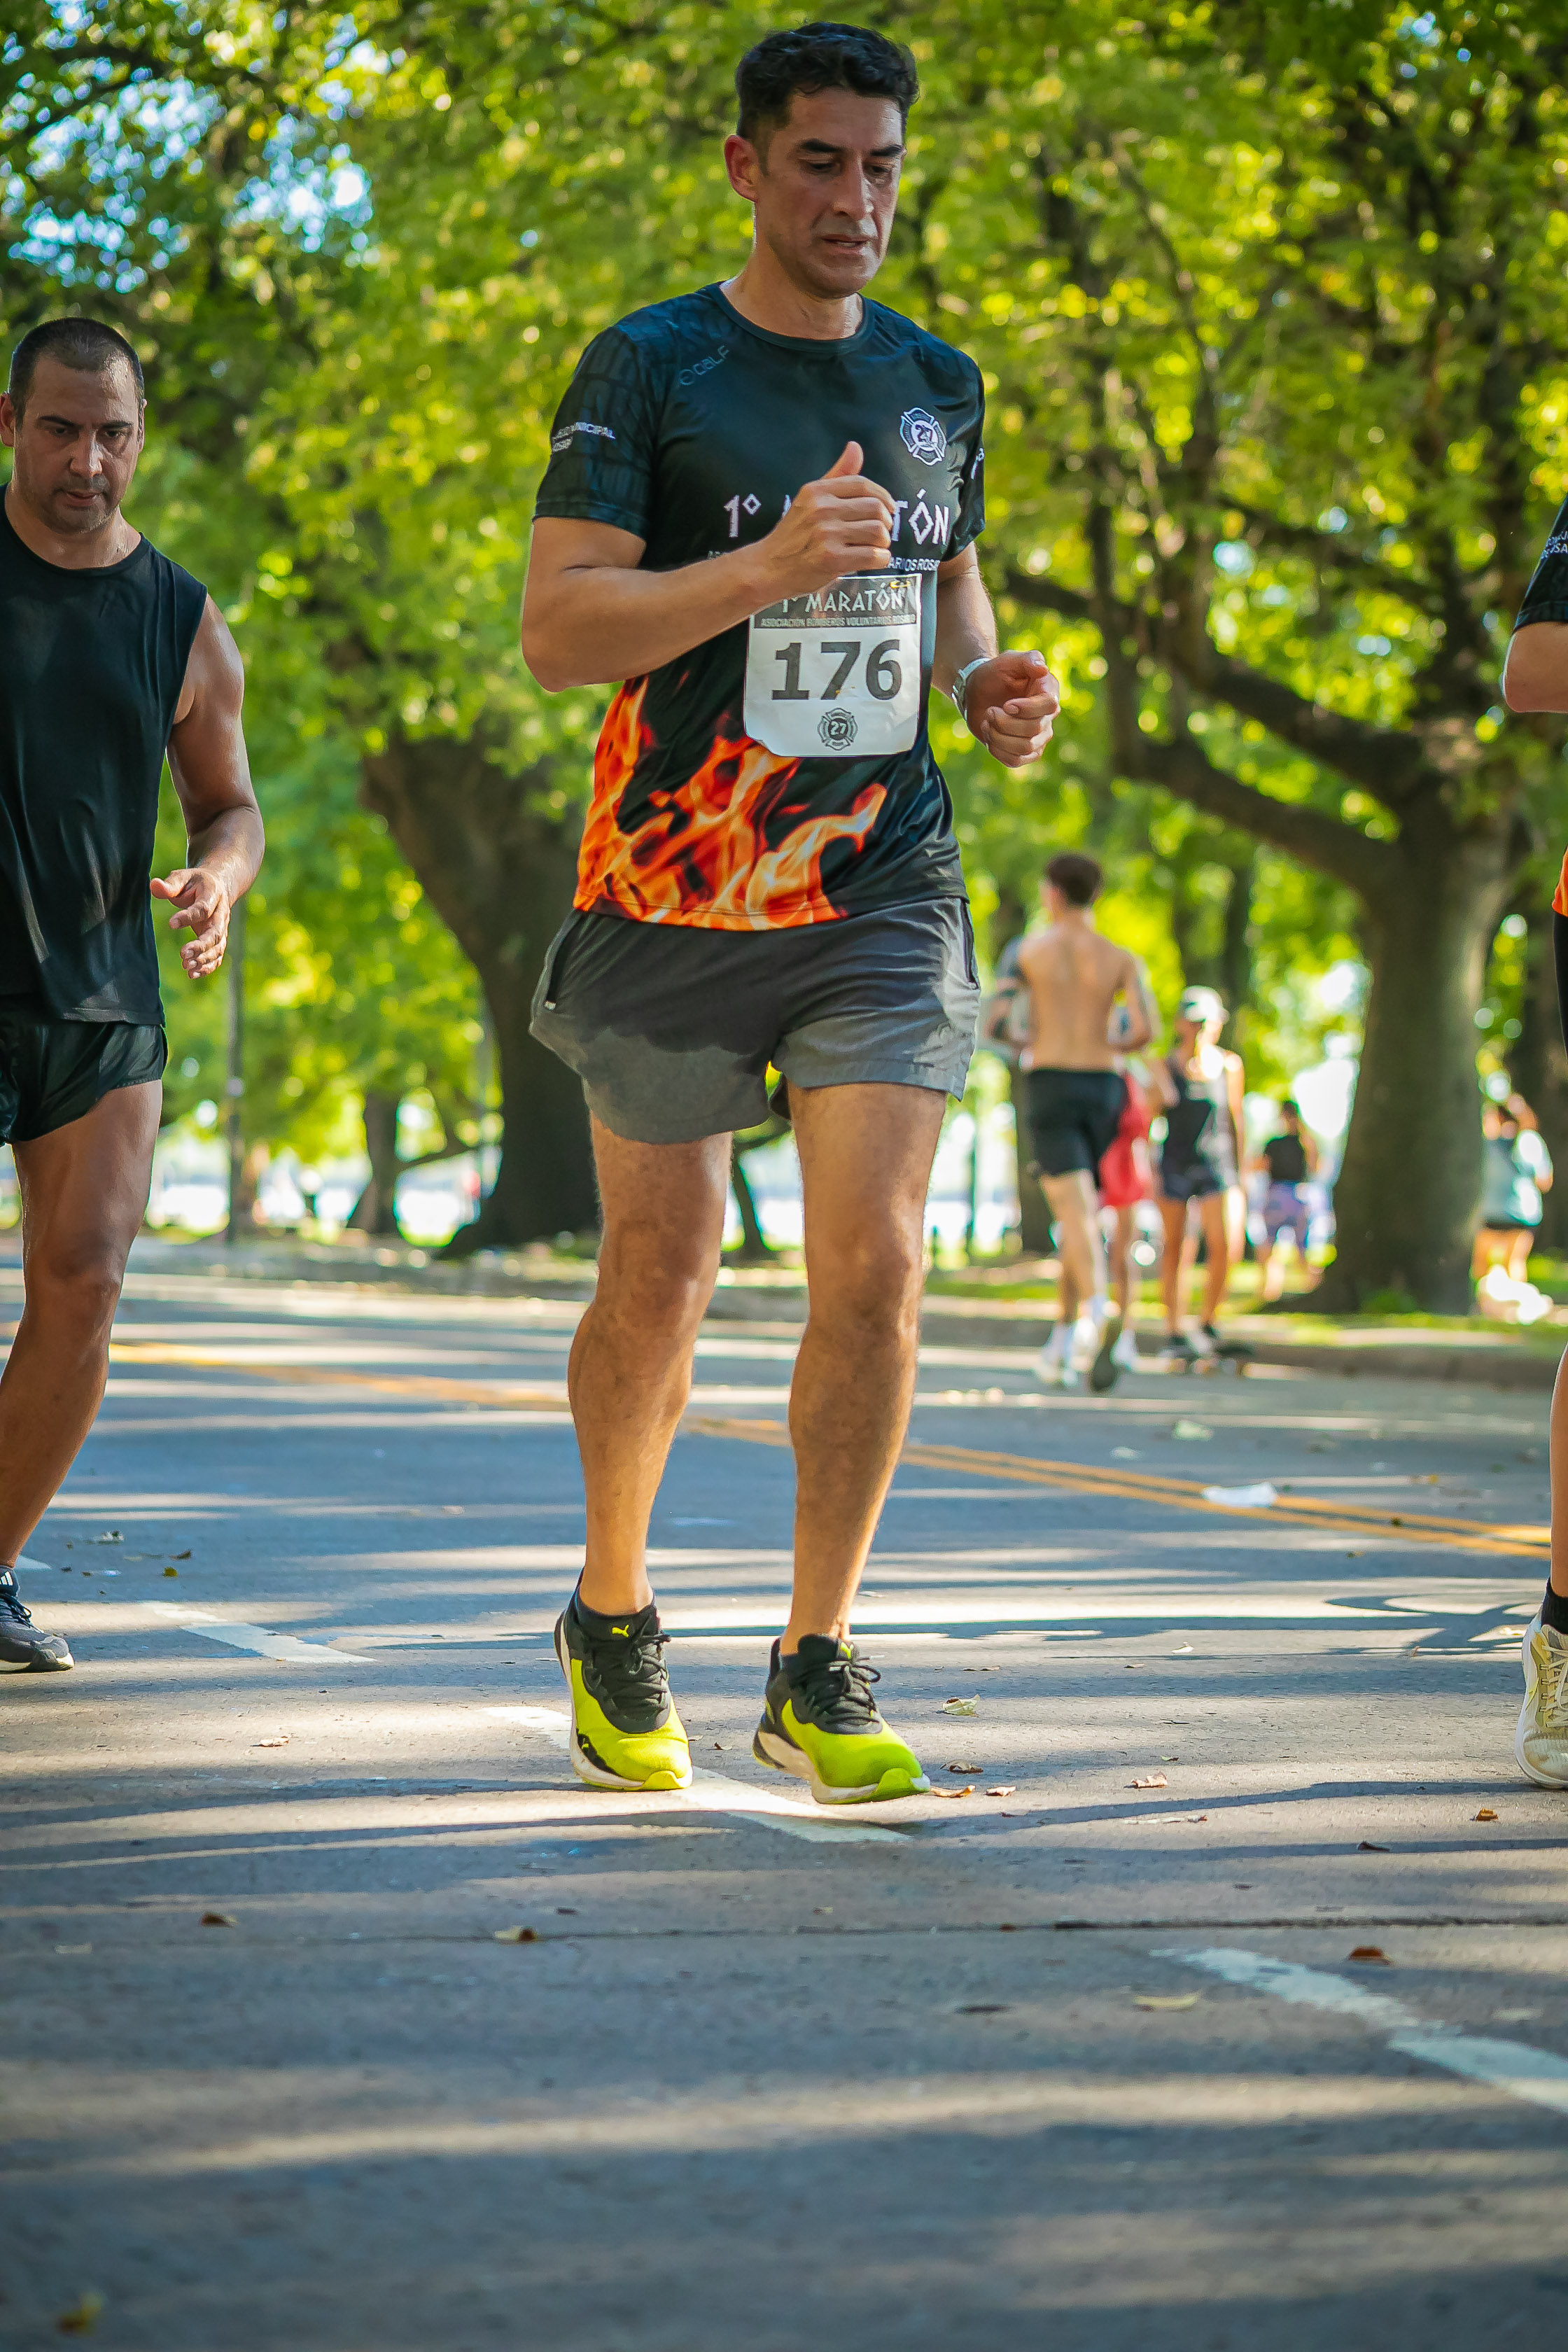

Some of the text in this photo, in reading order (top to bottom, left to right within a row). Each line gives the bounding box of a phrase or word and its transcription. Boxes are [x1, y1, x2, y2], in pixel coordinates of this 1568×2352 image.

[805, 582, 904, 612] MARATÓN
[771, 639, 902, 701] 176
[831, 721, 846, 735] 27
